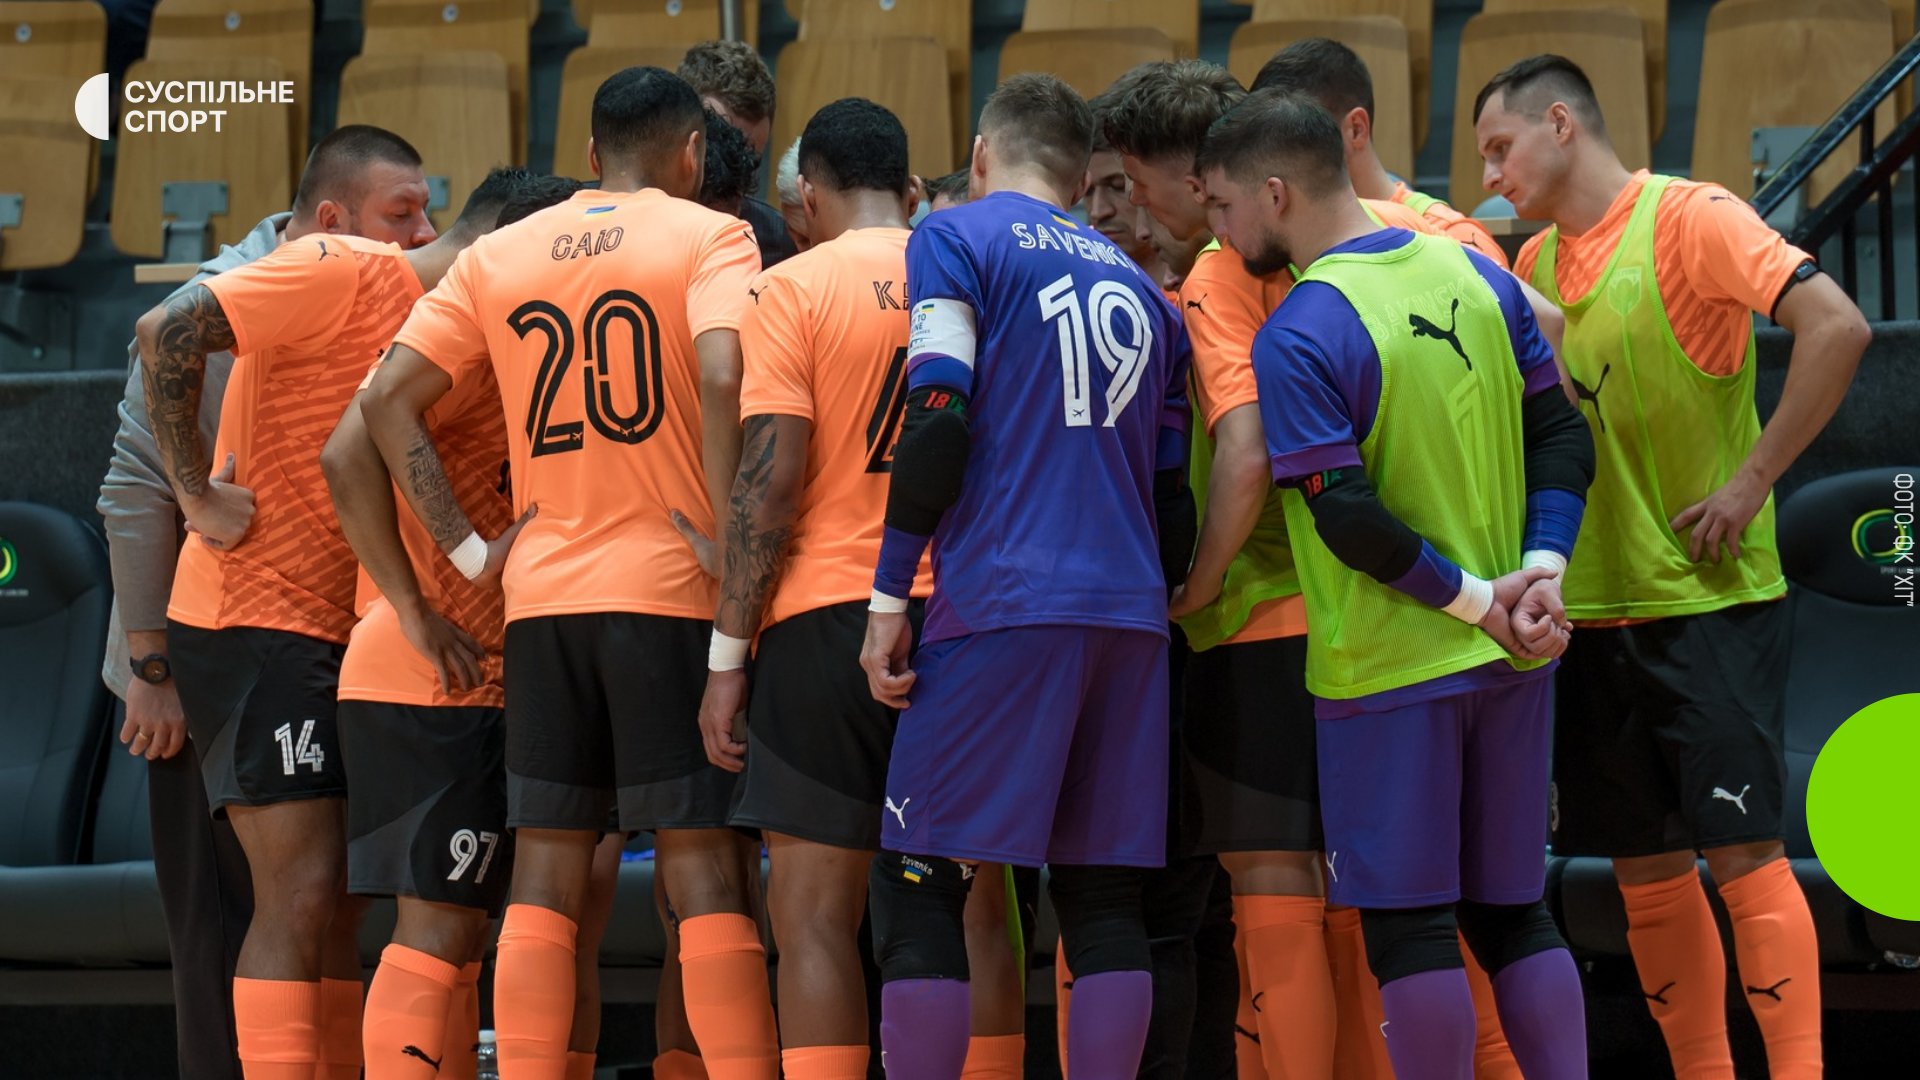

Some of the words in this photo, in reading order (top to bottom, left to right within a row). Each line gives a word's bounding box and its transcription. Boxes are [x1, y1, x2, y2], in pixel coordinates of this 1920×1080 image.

[551, 226, 625, 261] CAIO
[872, 281, 909, 311] K
[506, 289, 665, 459] 20
[1037, 273, 1153, 428] 19
[274, 719, 325, 775] 14
[446, 828, 499, 883] 97
[901, 855, 933, 876] Savenko
